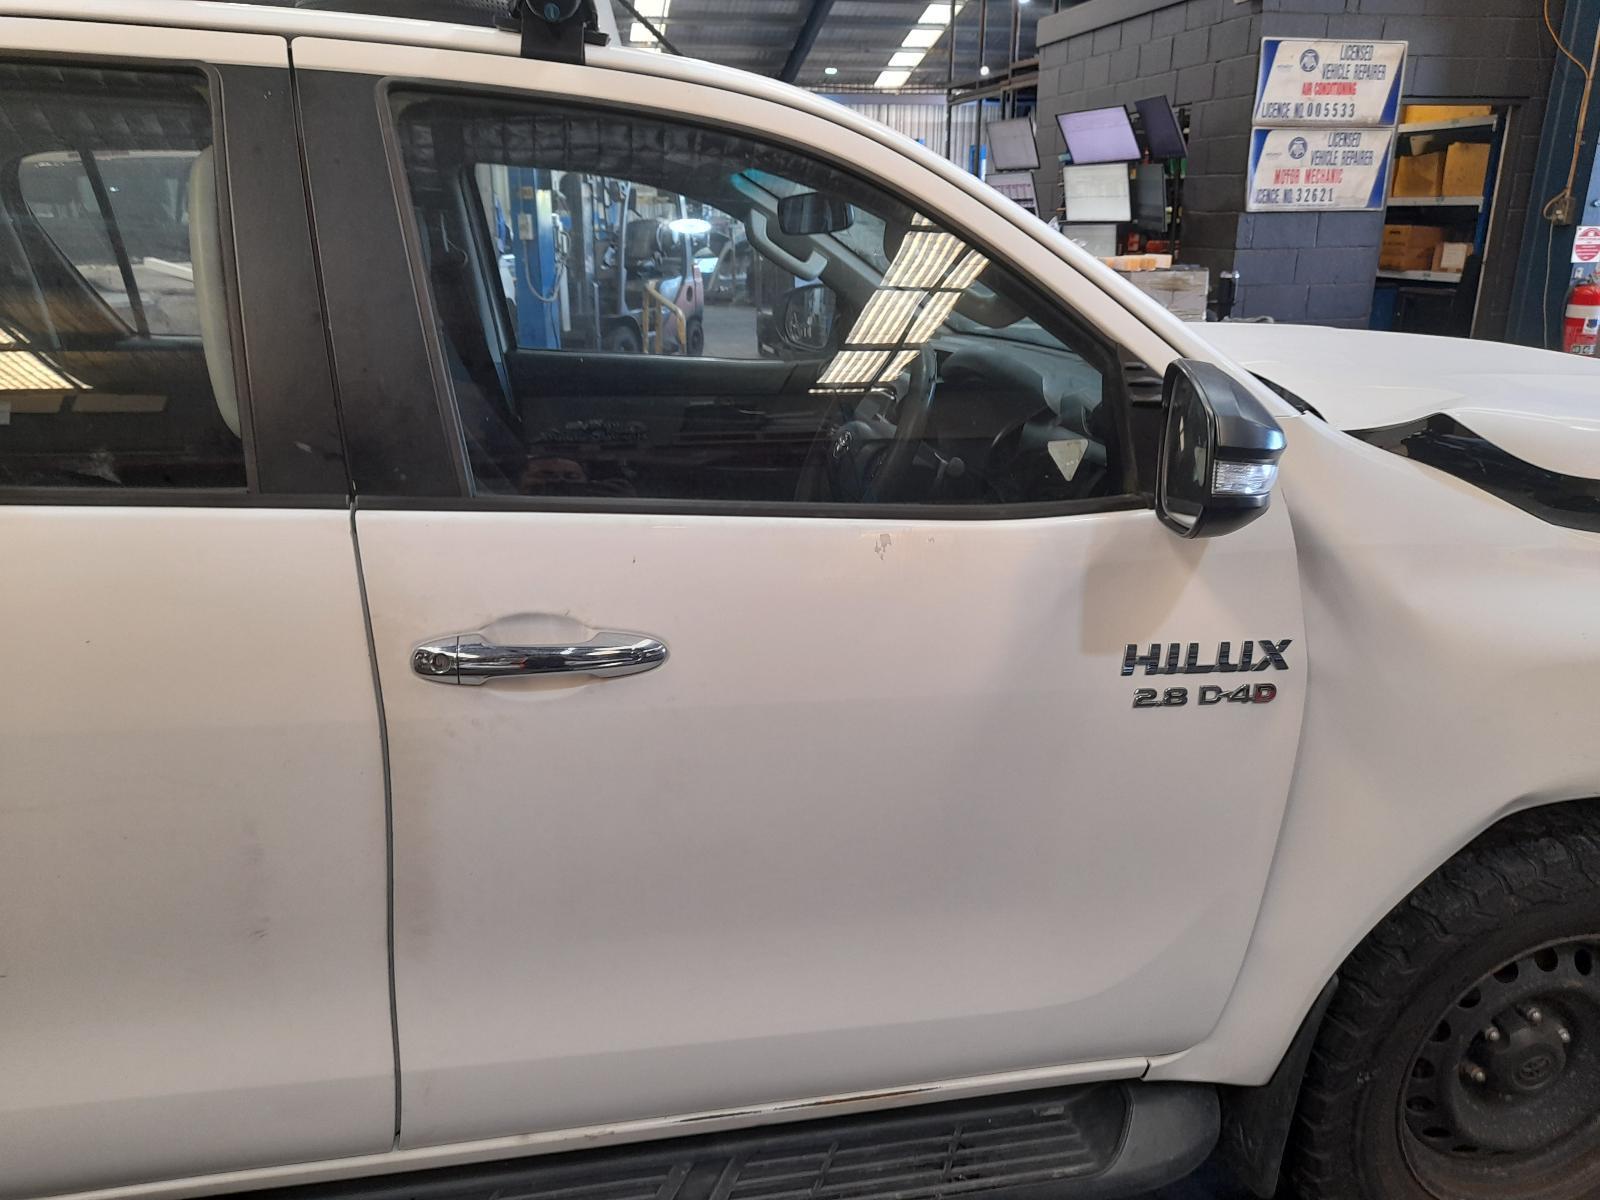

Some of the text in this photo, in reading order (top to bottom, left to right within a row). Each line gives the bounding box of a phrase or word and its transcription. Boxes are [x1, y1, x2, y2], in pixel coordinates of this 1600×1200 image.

[1341, 45, 1374, 61] LICENSED
[1322, 64, 1386, 80] VEHICLE REPAIRER
[1302, 82, 1357, 96] AIR CONDITIONING
[1262, 102, 1291, 118] LICENCE
[1307, 103, 1355, 118] 005533
[1328, 132, 1362, 148] LICENSED
[1311, 150, 1374, 166] VEHICLE REPAIRER
[1273, 168, 1344, 185] MOTOR MECHANIC
[1296, 188, 1334, 202] 32621
[1120, 638, 1293, 676] HILUX
[1132, 682, 1277, 708] 2.8 D-4D
